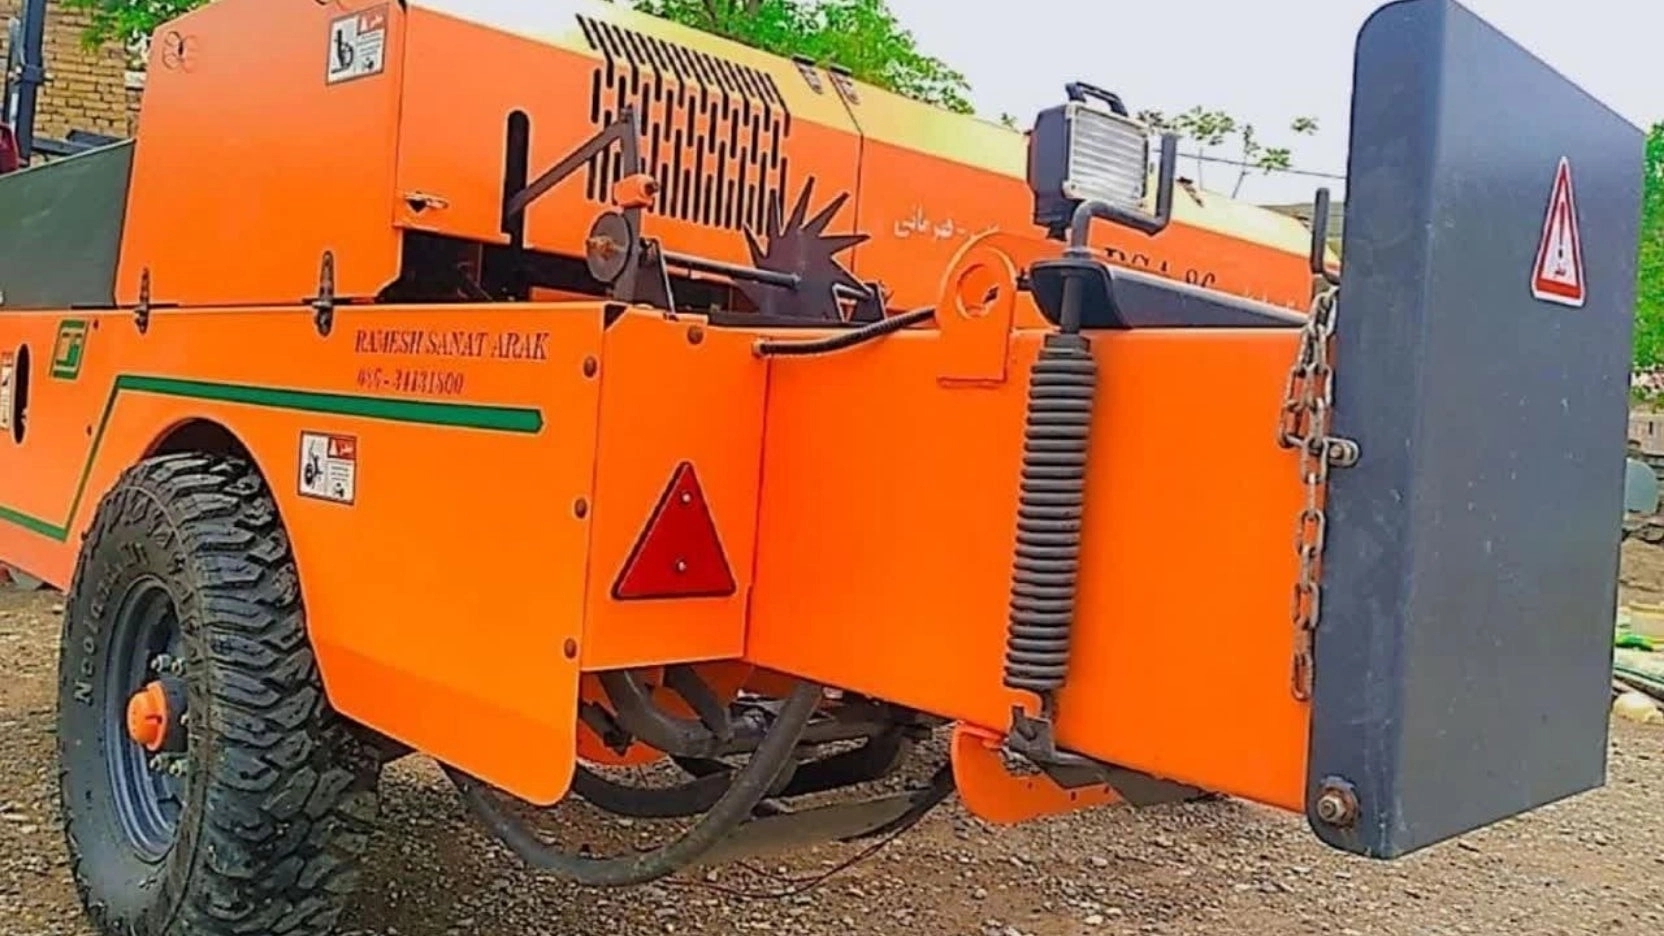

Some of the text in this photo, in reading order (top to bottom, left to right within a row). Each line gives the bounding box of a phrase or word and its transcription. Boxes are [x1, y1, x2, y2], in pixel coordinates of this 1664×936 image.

[355, 329, 549, 360] RAMESH SANAT ARAK
